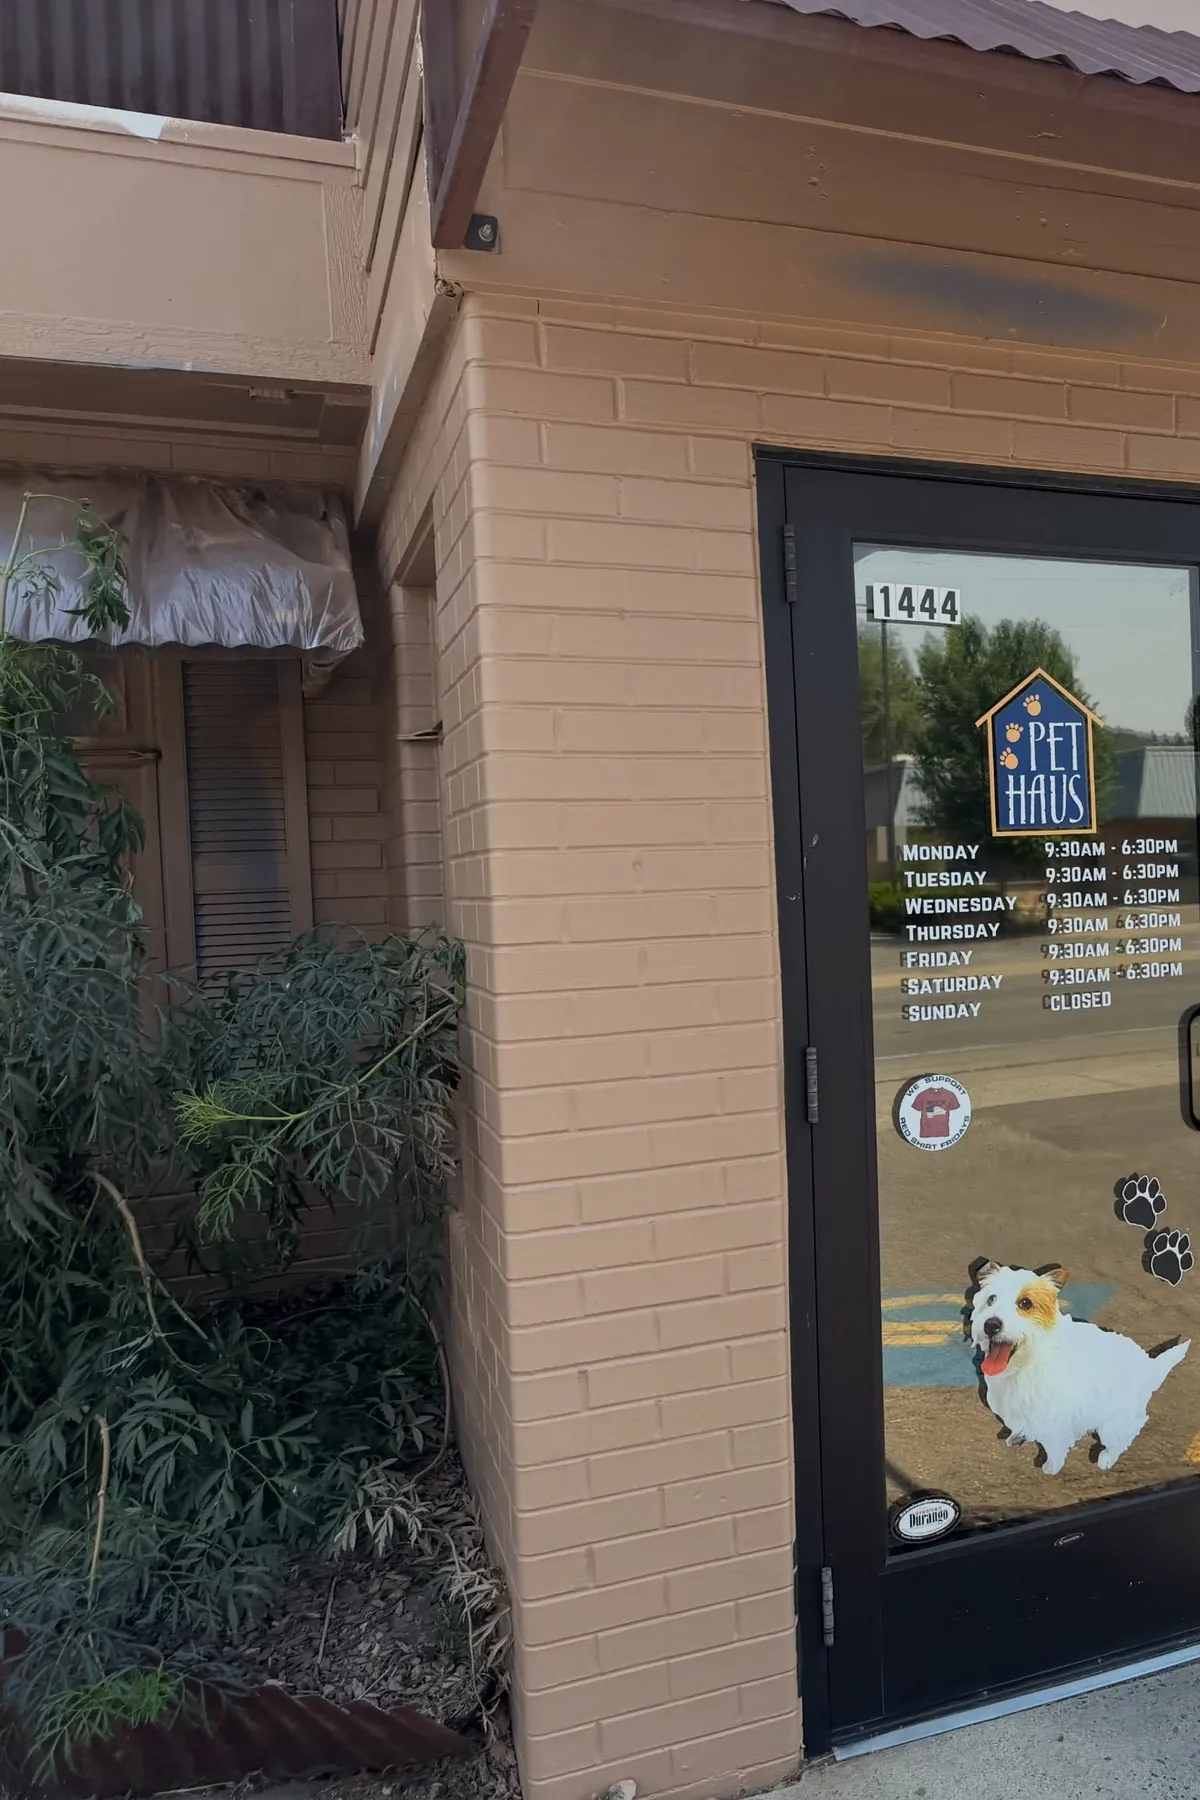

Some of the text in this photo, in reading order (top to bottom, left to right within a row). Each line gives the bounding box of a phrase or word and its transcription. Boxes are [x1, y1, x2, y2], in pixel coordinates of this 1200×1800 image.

[879, 585, 959, 622] 1444
[1028, 721, 1083, 772] PET
[1005, 773, 1085, 825] HAUS
[903, 844, 980, 861] MONDAY
[1044, 841, 1106, 858] 9:30AM
[1121, 838, 1178, 855] 6:30PM
[904, 871, 987, 888] TUESDAY
[1045, 866, 1107, 883] 9:30AM
[1122, 863, 1179, 880] 6:30PM
[905, 896, 1017, 915] WEDNESDAY
[1047, 891, 1108, 909] 9:30AM
[1123, 888, 1180, 905] 6:30PM
[906, 913, 1181, 941] THURSDAY 9:30AM 6:30PM
[906, 950, 973, 968] FRIDAY
[1049, 942, 1109, 960] 9:30AM
[1125, 938, 1182, 955] 6:30PM
[907, 975, 1004, 995] SATURDAY
[1050, 967, 1110, 986] 9:30AM
[1126, 962, 1183, 979] 6:30PM
[908, 991, 1112, 1022] SUNDAY CLOSED
[906, 1076, 967, 1097] WE SUPPORT
[900, 1115, 970, 1150] RED SHIRT FRIDAYS
[909, 1508, 949, 1528] Durango
